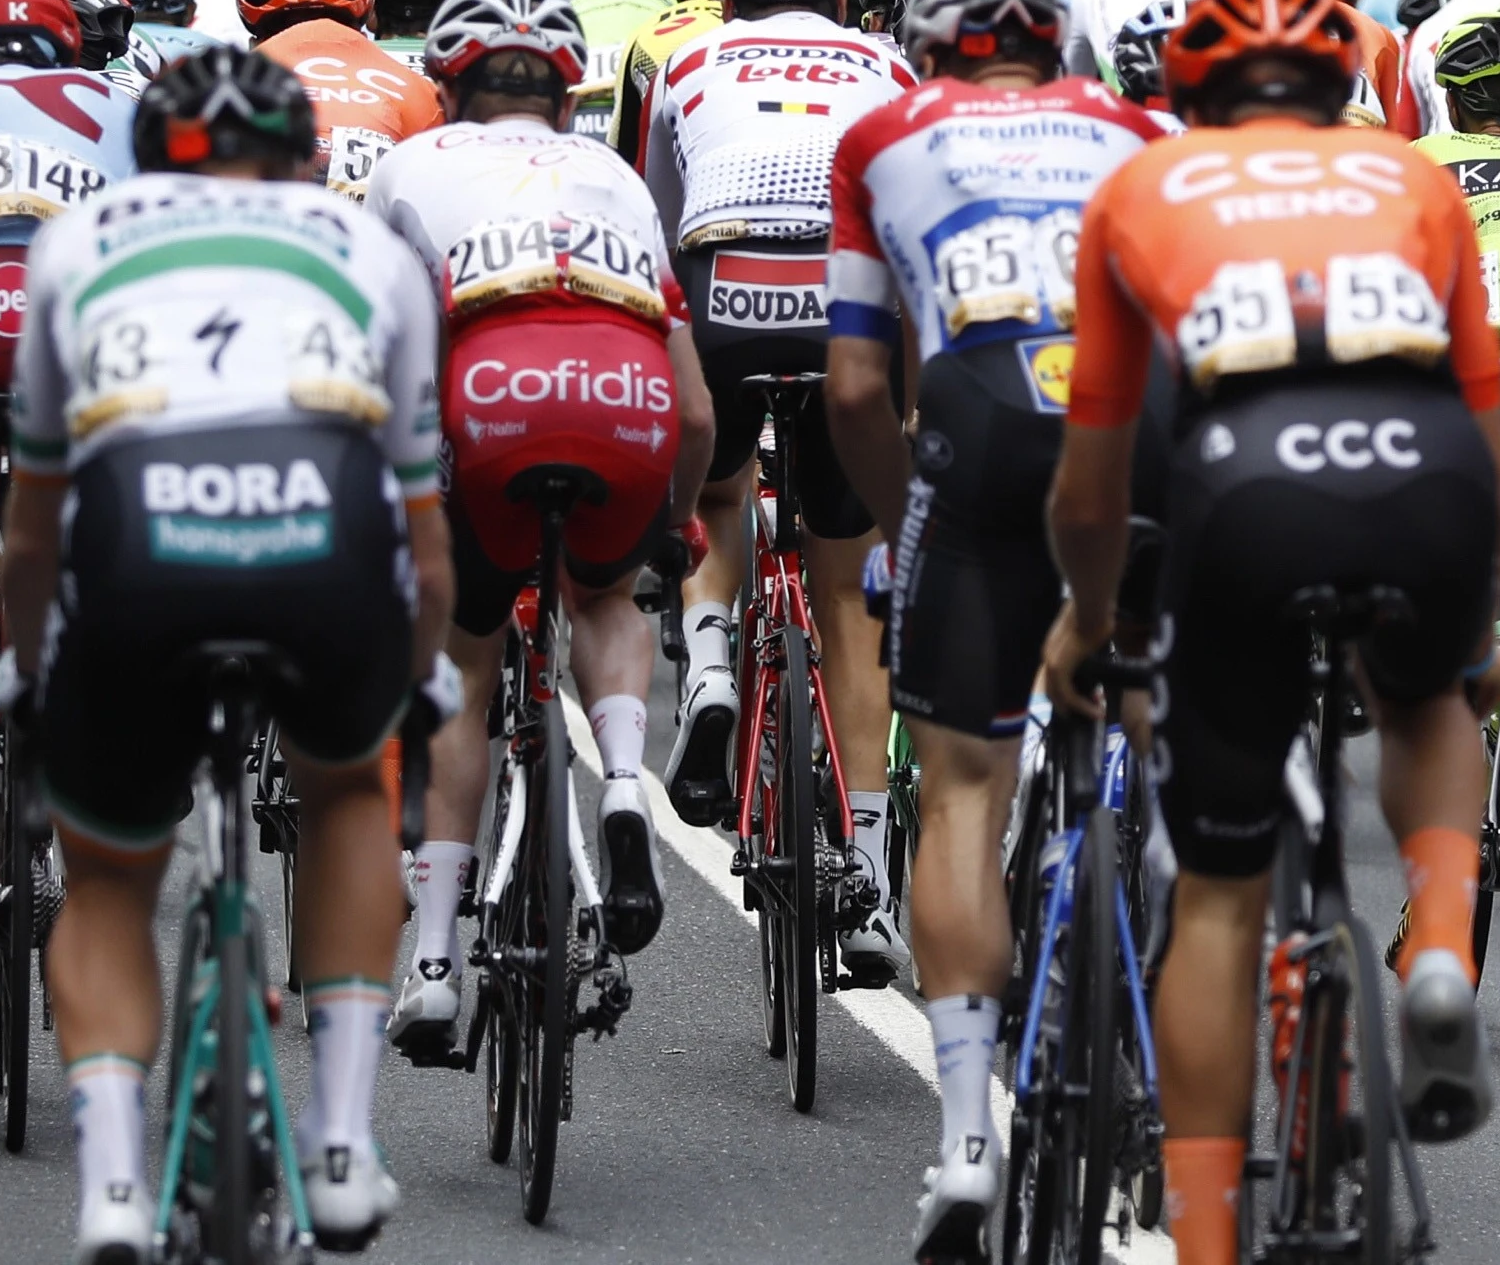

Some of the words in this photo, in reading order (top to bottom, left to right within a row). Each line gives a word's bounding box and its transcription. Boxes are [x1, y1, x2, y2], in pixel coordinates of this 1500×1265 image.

[9, 1, 29, 21] K
[716, 48, 882, 77] SOUDAL
[736, 63, 859, 86] Lotto
[304, 86, 381, 105] ENO
[574, 115, 612, 135] MU
[25, 152, 106, 206] 148
[1161, 150, 1407, 204] CCC
[1212, 188, 1379, 226] RENO
[449, 220, 553, 287] 204
[571, 220, 658, 291] 204
[949, 233, 1019, 295] 65
[463, 357, 672, 414] Cofidis
[1275, 418, 1421, 473] CCC
[142, 458, 333, 517] BORA
[155, 517, 327, 563] hansgrohe
